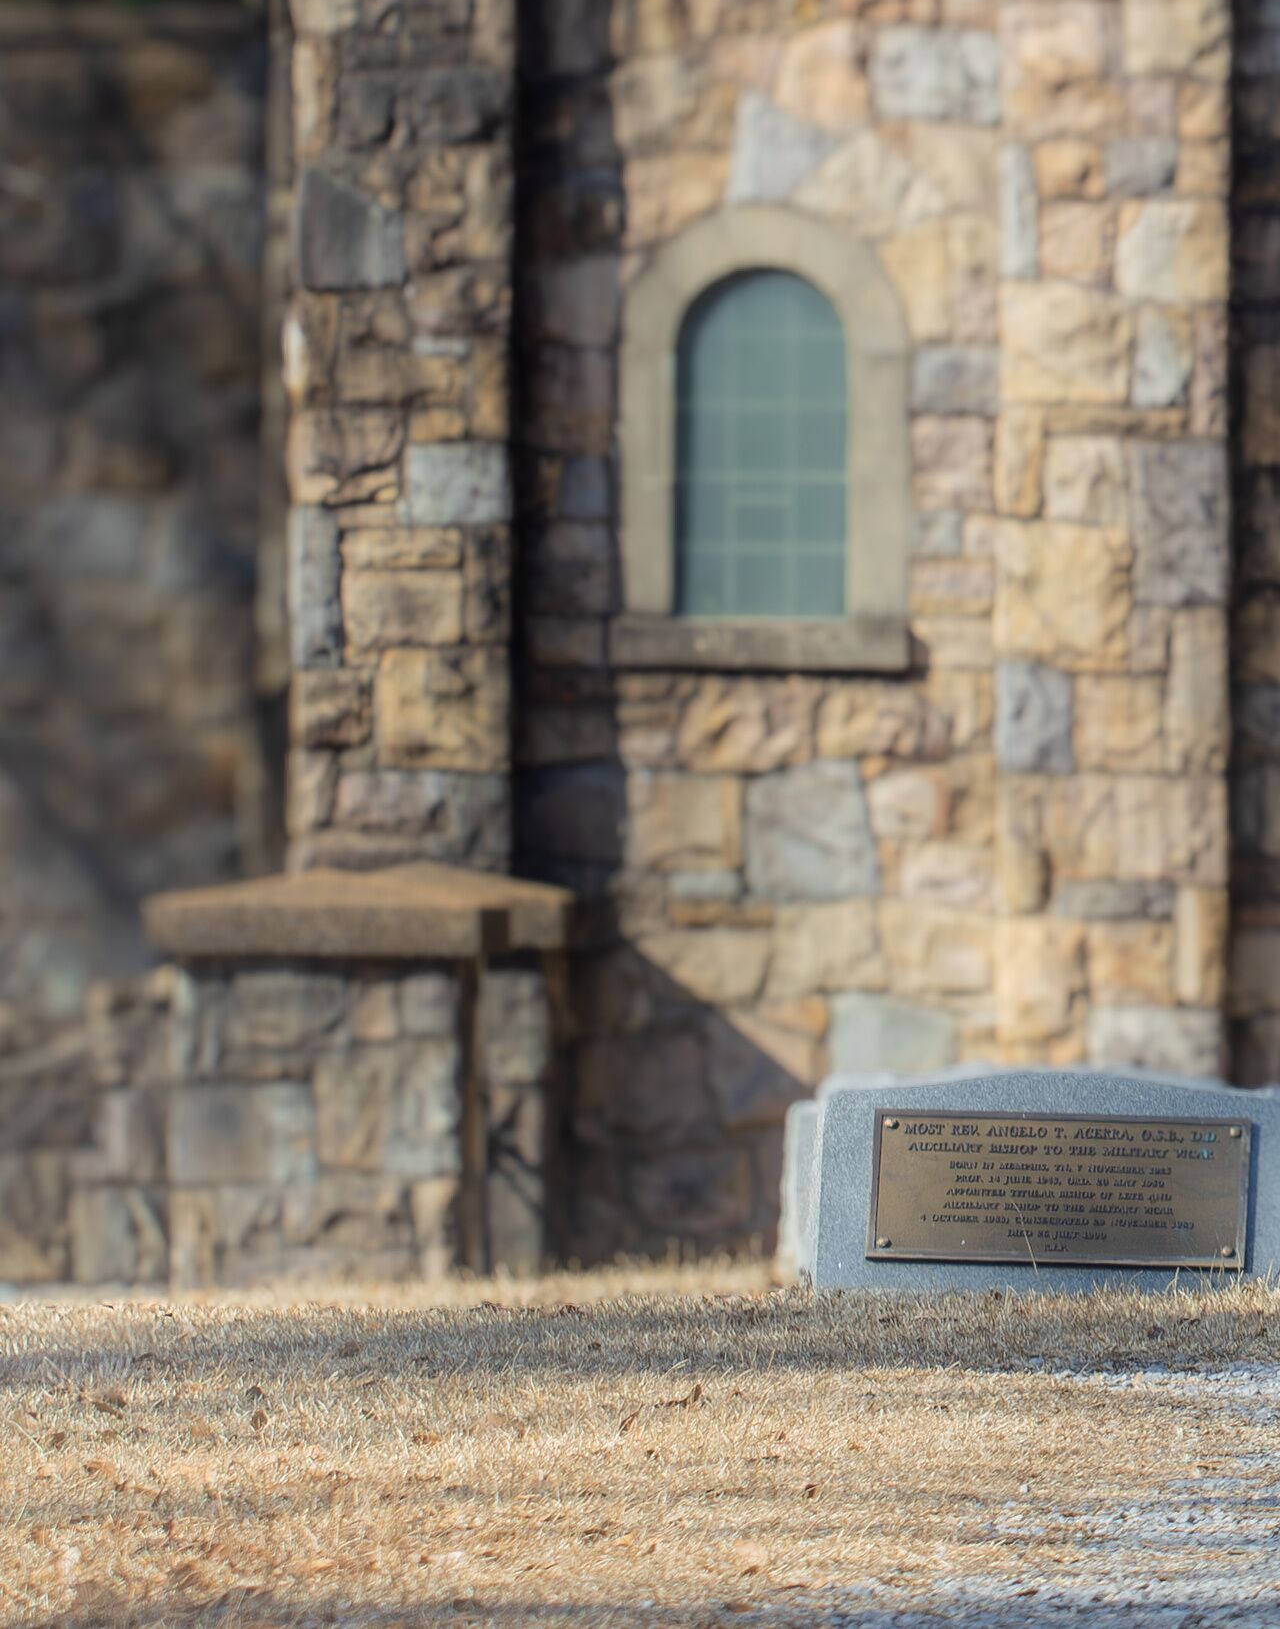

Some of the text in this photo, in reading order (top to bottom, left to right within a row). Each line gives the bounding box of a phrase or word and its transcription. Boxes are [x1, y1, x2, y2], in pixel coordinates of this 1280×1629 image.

[904, 1122, 946, 1135] MOST
[951, 1124, 980, 1137] REV.
[986, 1125, 1048, 1138] ANGELO
[1054, 1126, 1068, 1139] T.
[1073, 1127, 1135, 1142] ACERRA,
[908, 1141, 983, 1154] AUXILIARY
[988, 1143, 1038, 1155] BISHOP
[1043, 1144, 1063, 1156] TO
[1068, 1145, 1097, 1157] THE
[1102, 1147, 1169, 1159] MILITARY
[949, 1160, 979, 1170] BORN
[1058, 1190, 1096, 1200] BISHOP
[932, 1214, 980, 1224] OCTOBER
